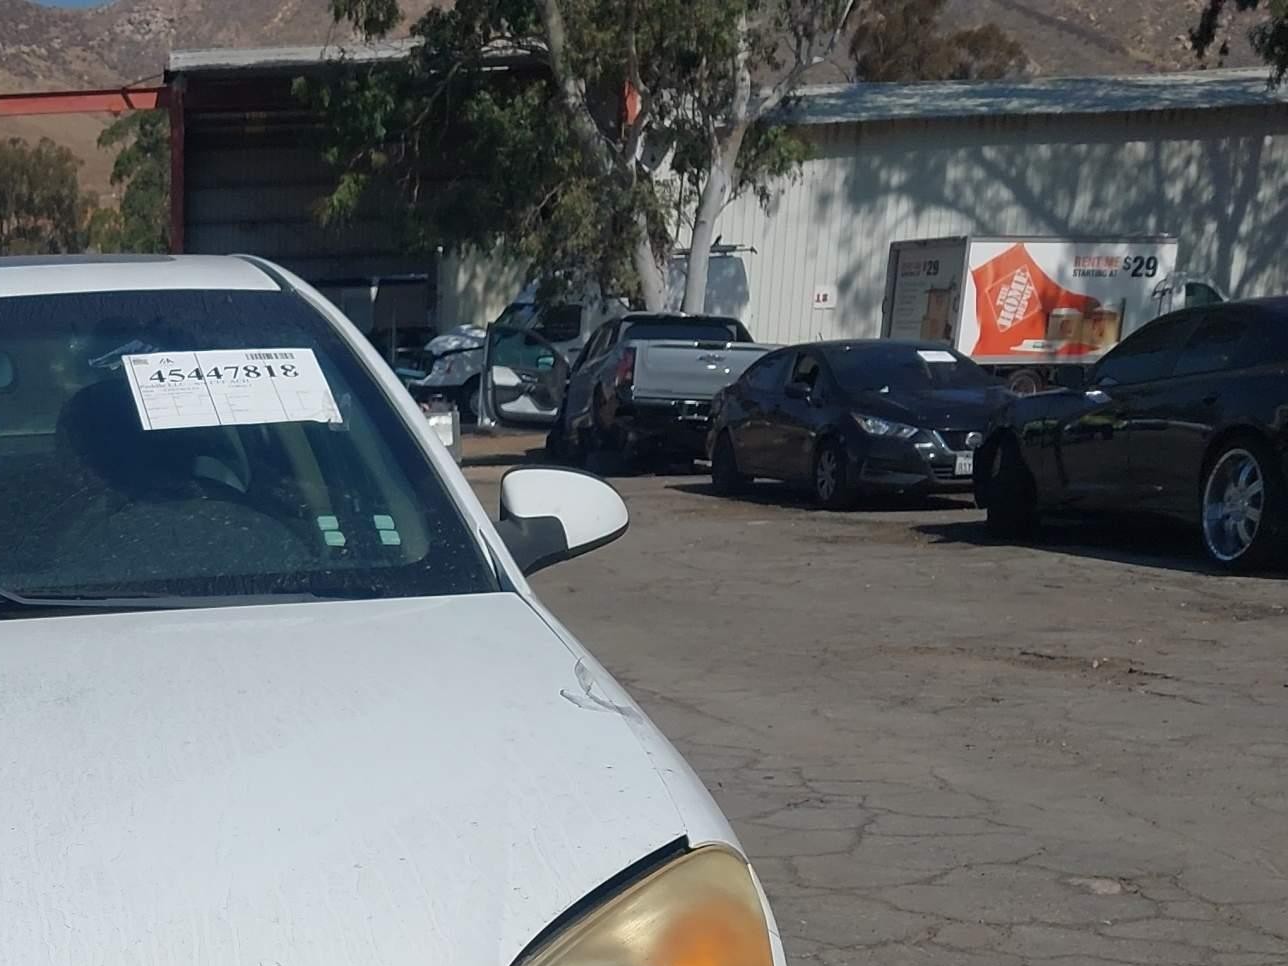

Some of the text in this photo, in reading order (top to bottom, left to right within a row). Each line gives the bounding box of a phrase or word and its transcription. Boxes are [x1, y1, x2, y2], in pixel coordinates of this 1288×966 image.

[1123, 255, 1158, 278] $29
[997, 267, 1029, 332] HOME
[149, 364, 300, 383] 45447818
